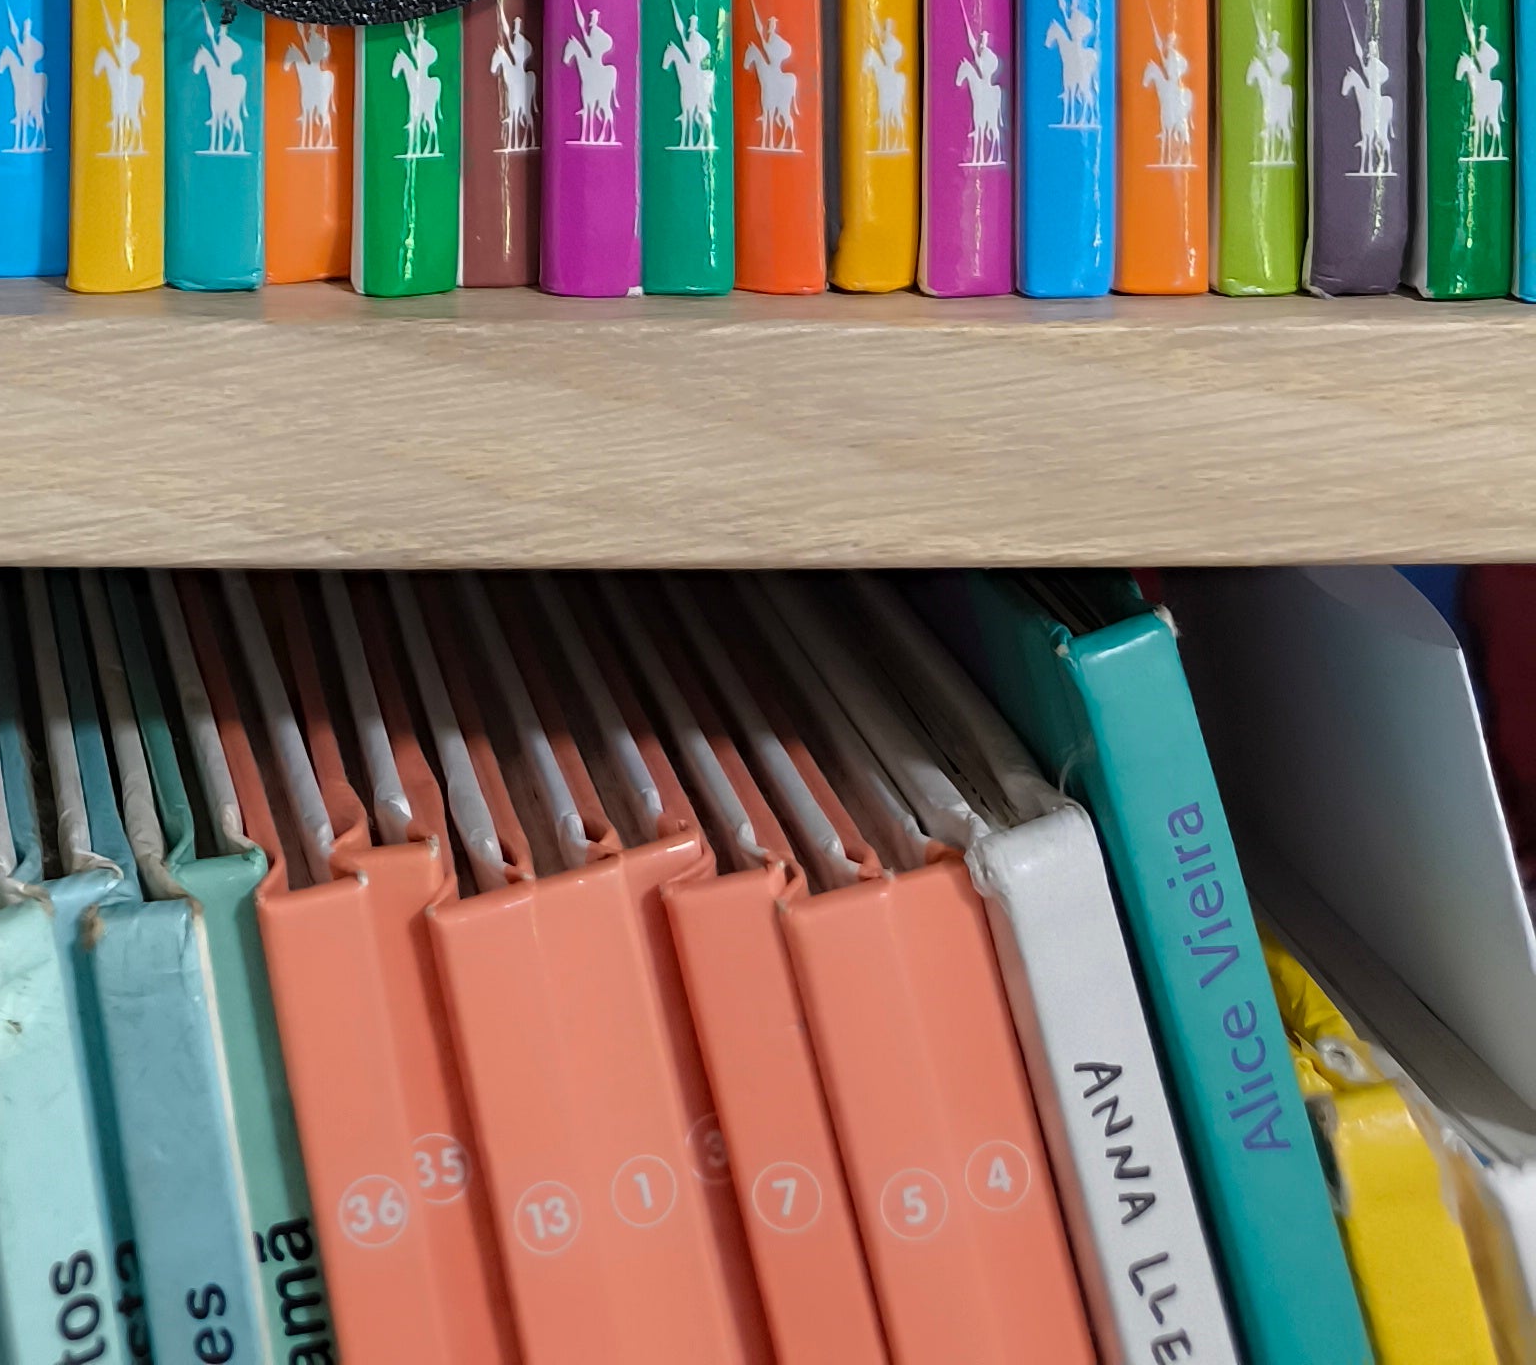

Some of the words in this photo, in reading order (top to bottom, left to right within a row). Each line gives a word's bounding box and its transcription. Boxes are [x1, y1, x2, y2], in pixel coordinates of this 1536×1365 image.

[1166, 801, 1241, 989] Vieira
[1225, 998, 1291, 1152] Alice
[1073, 1062, 1157, 1225] ANNA
[412, 1145, 465, 1189] 35
[986, 1157, 1011, 1192] 4
[346, 1186, 404, 1234] 36
[633, 1173, 653, 1208] 1
[773, 1179, 797, 1216] 7
[903, 1186, 927, 1223] 5
[526, 1196, 572, 1240] 13
